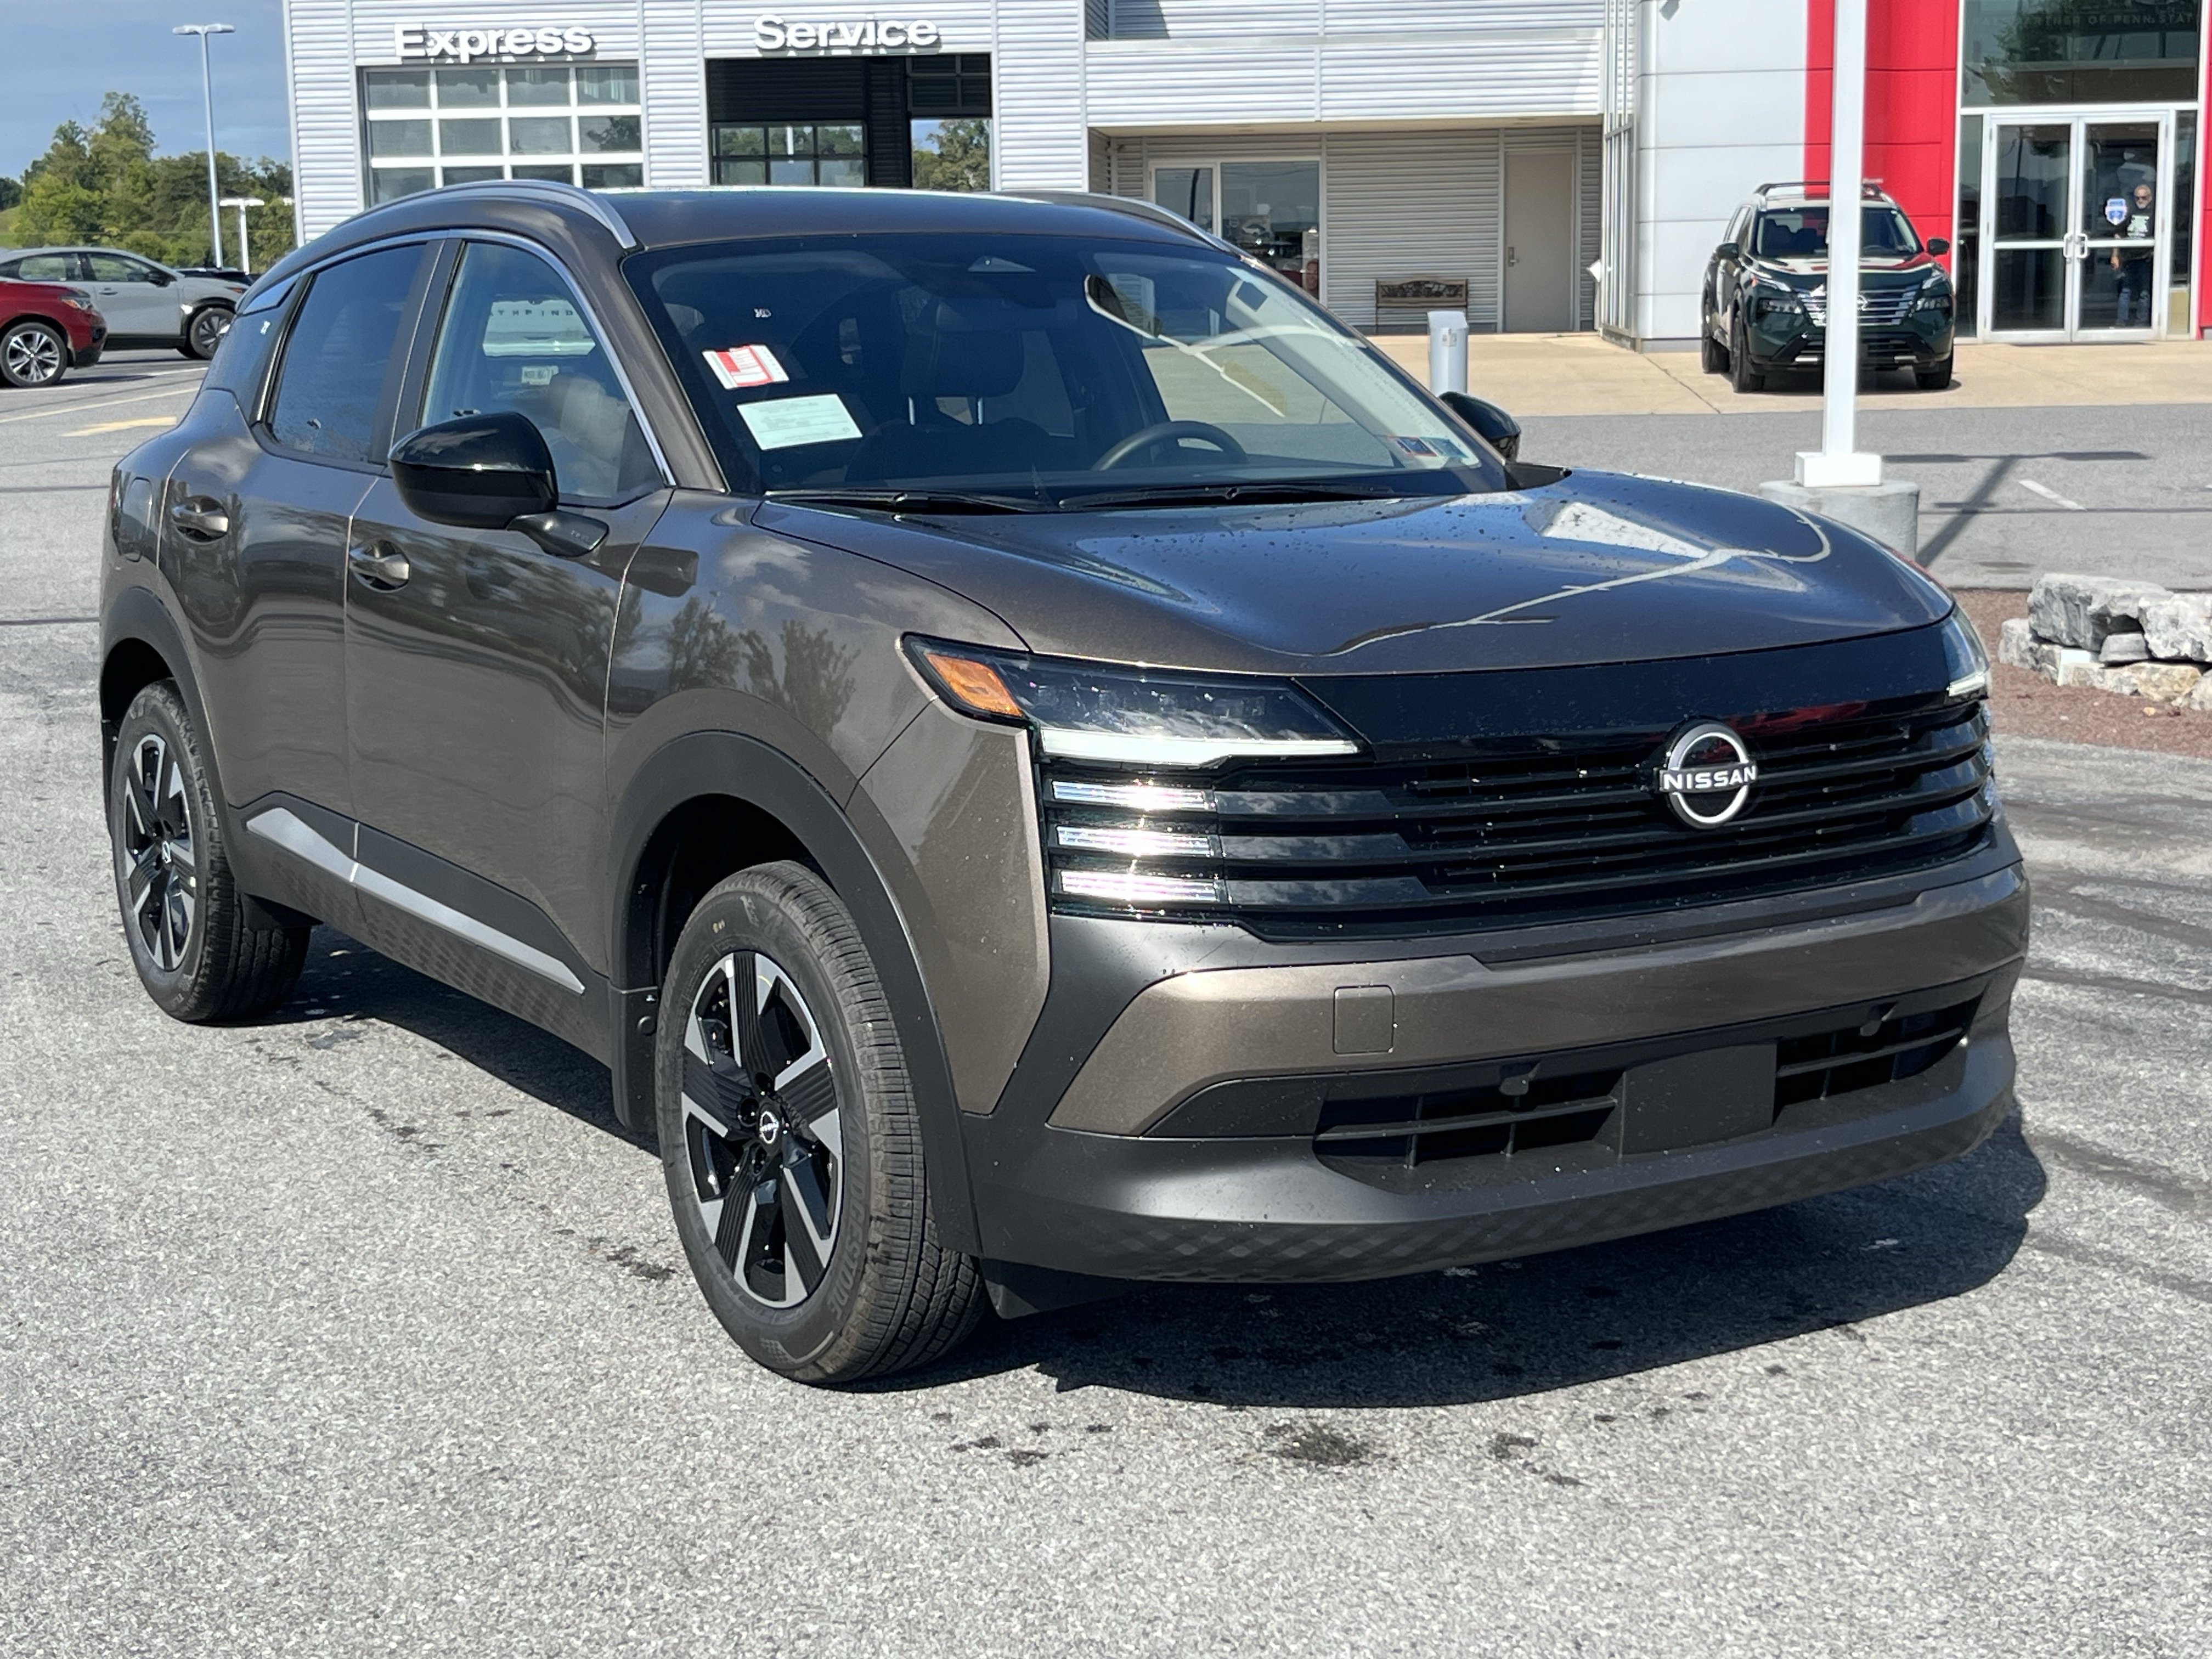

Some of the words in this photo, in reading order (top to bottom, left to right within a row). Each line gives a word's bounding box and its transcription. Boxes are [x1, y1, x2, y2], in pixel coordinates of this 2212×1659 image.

[394, 22, 593, 64] Express
[754, 14, 939, 49] Service
[1663, 765, 1757, 790] NISSAN
